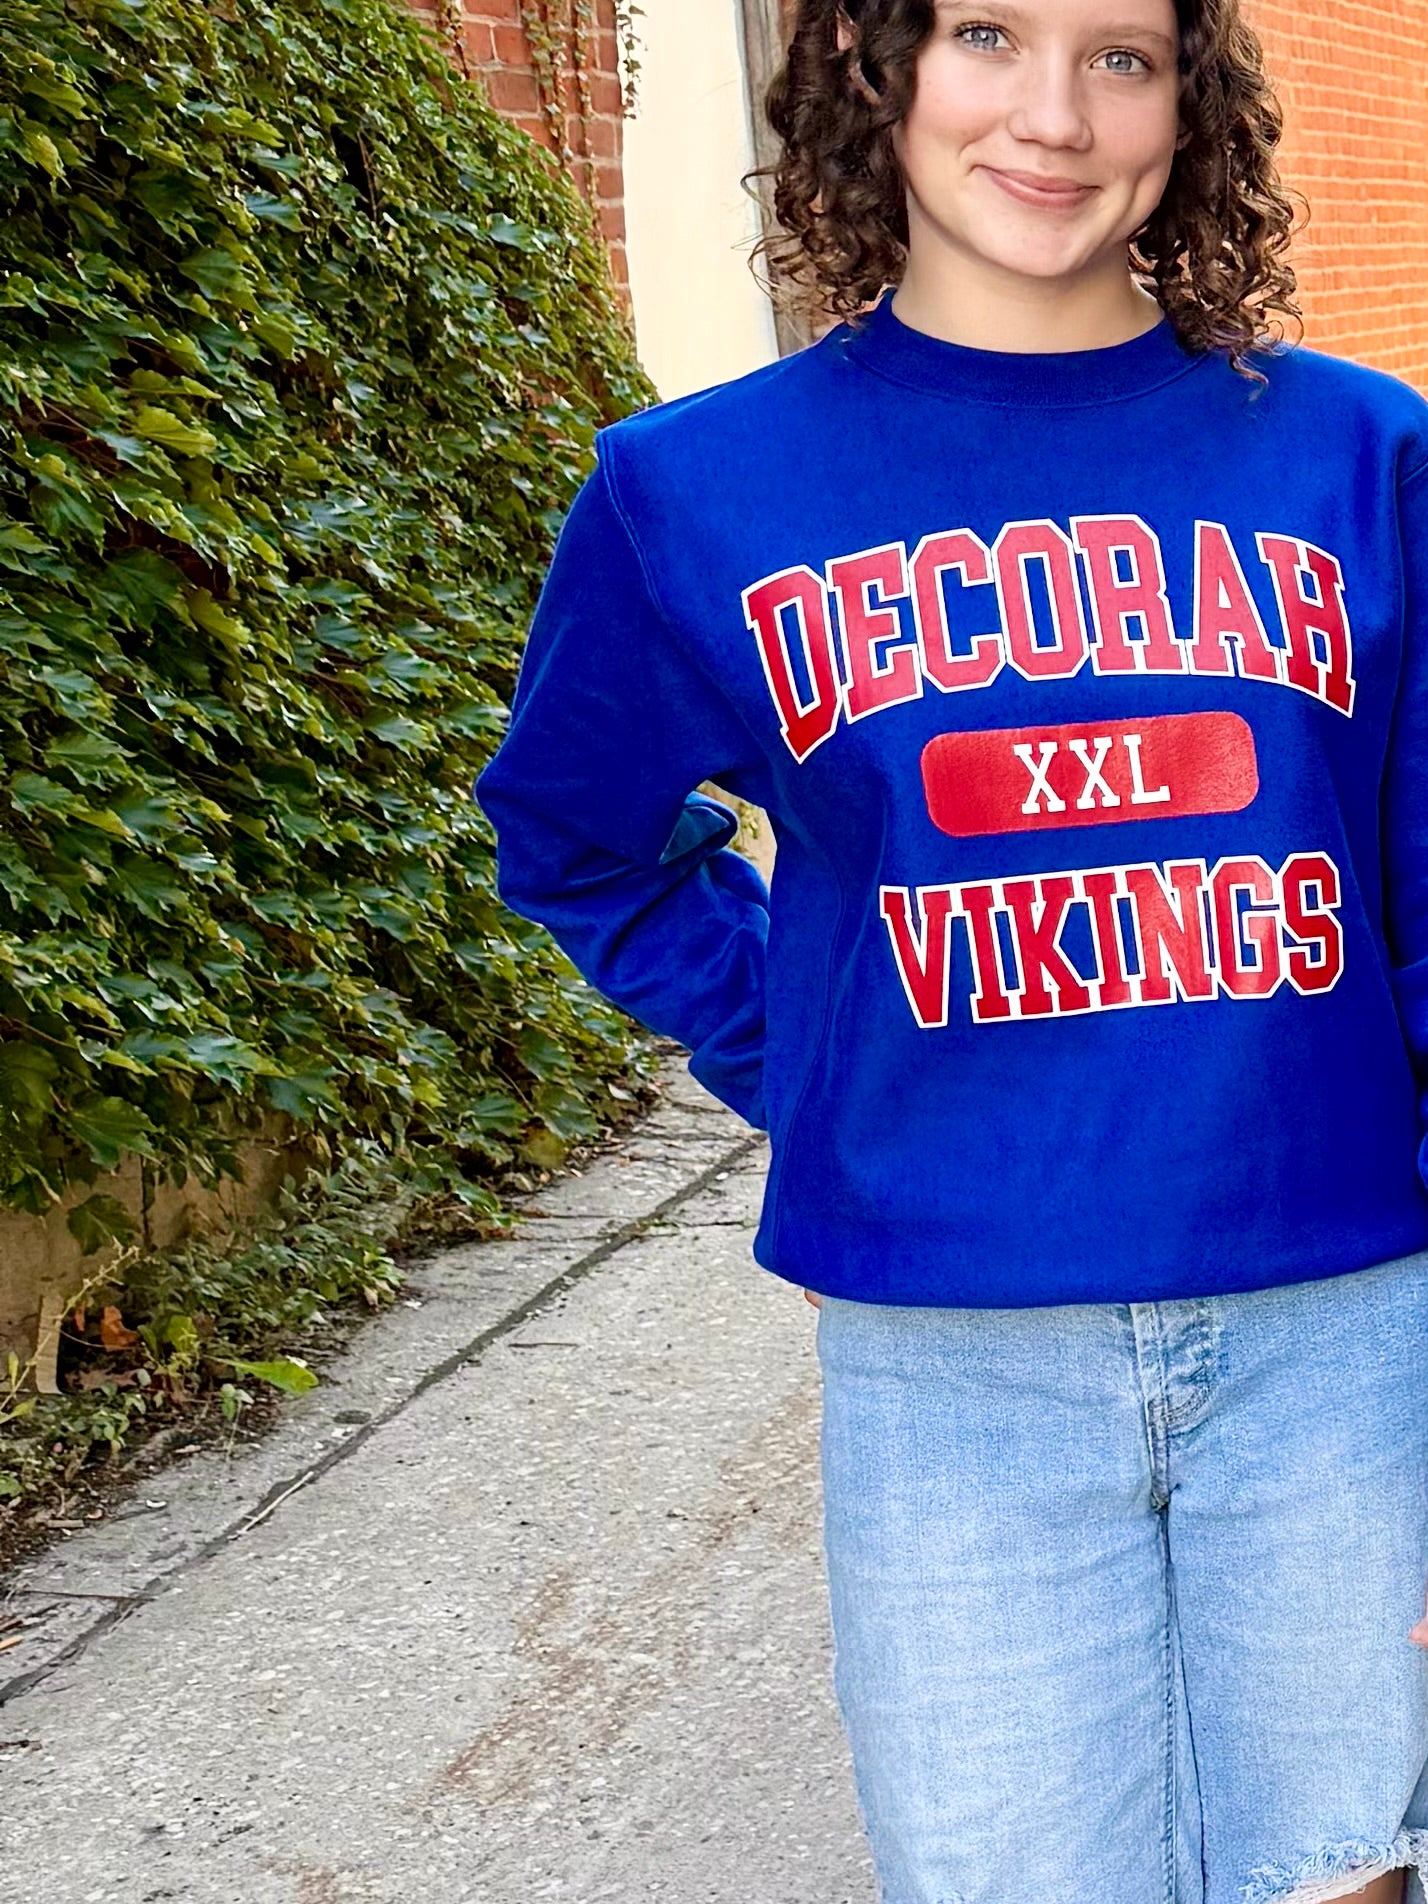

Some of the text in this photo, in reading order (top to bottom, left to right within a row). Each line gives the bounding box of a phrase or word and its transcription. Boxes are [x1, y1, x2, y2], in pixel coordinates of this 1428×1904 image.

[742, 514, 1356, 764] DECORAH
[1013, 733, 1171, 815] XXL
[880, 851, 1345, 1029] VIKINGS
